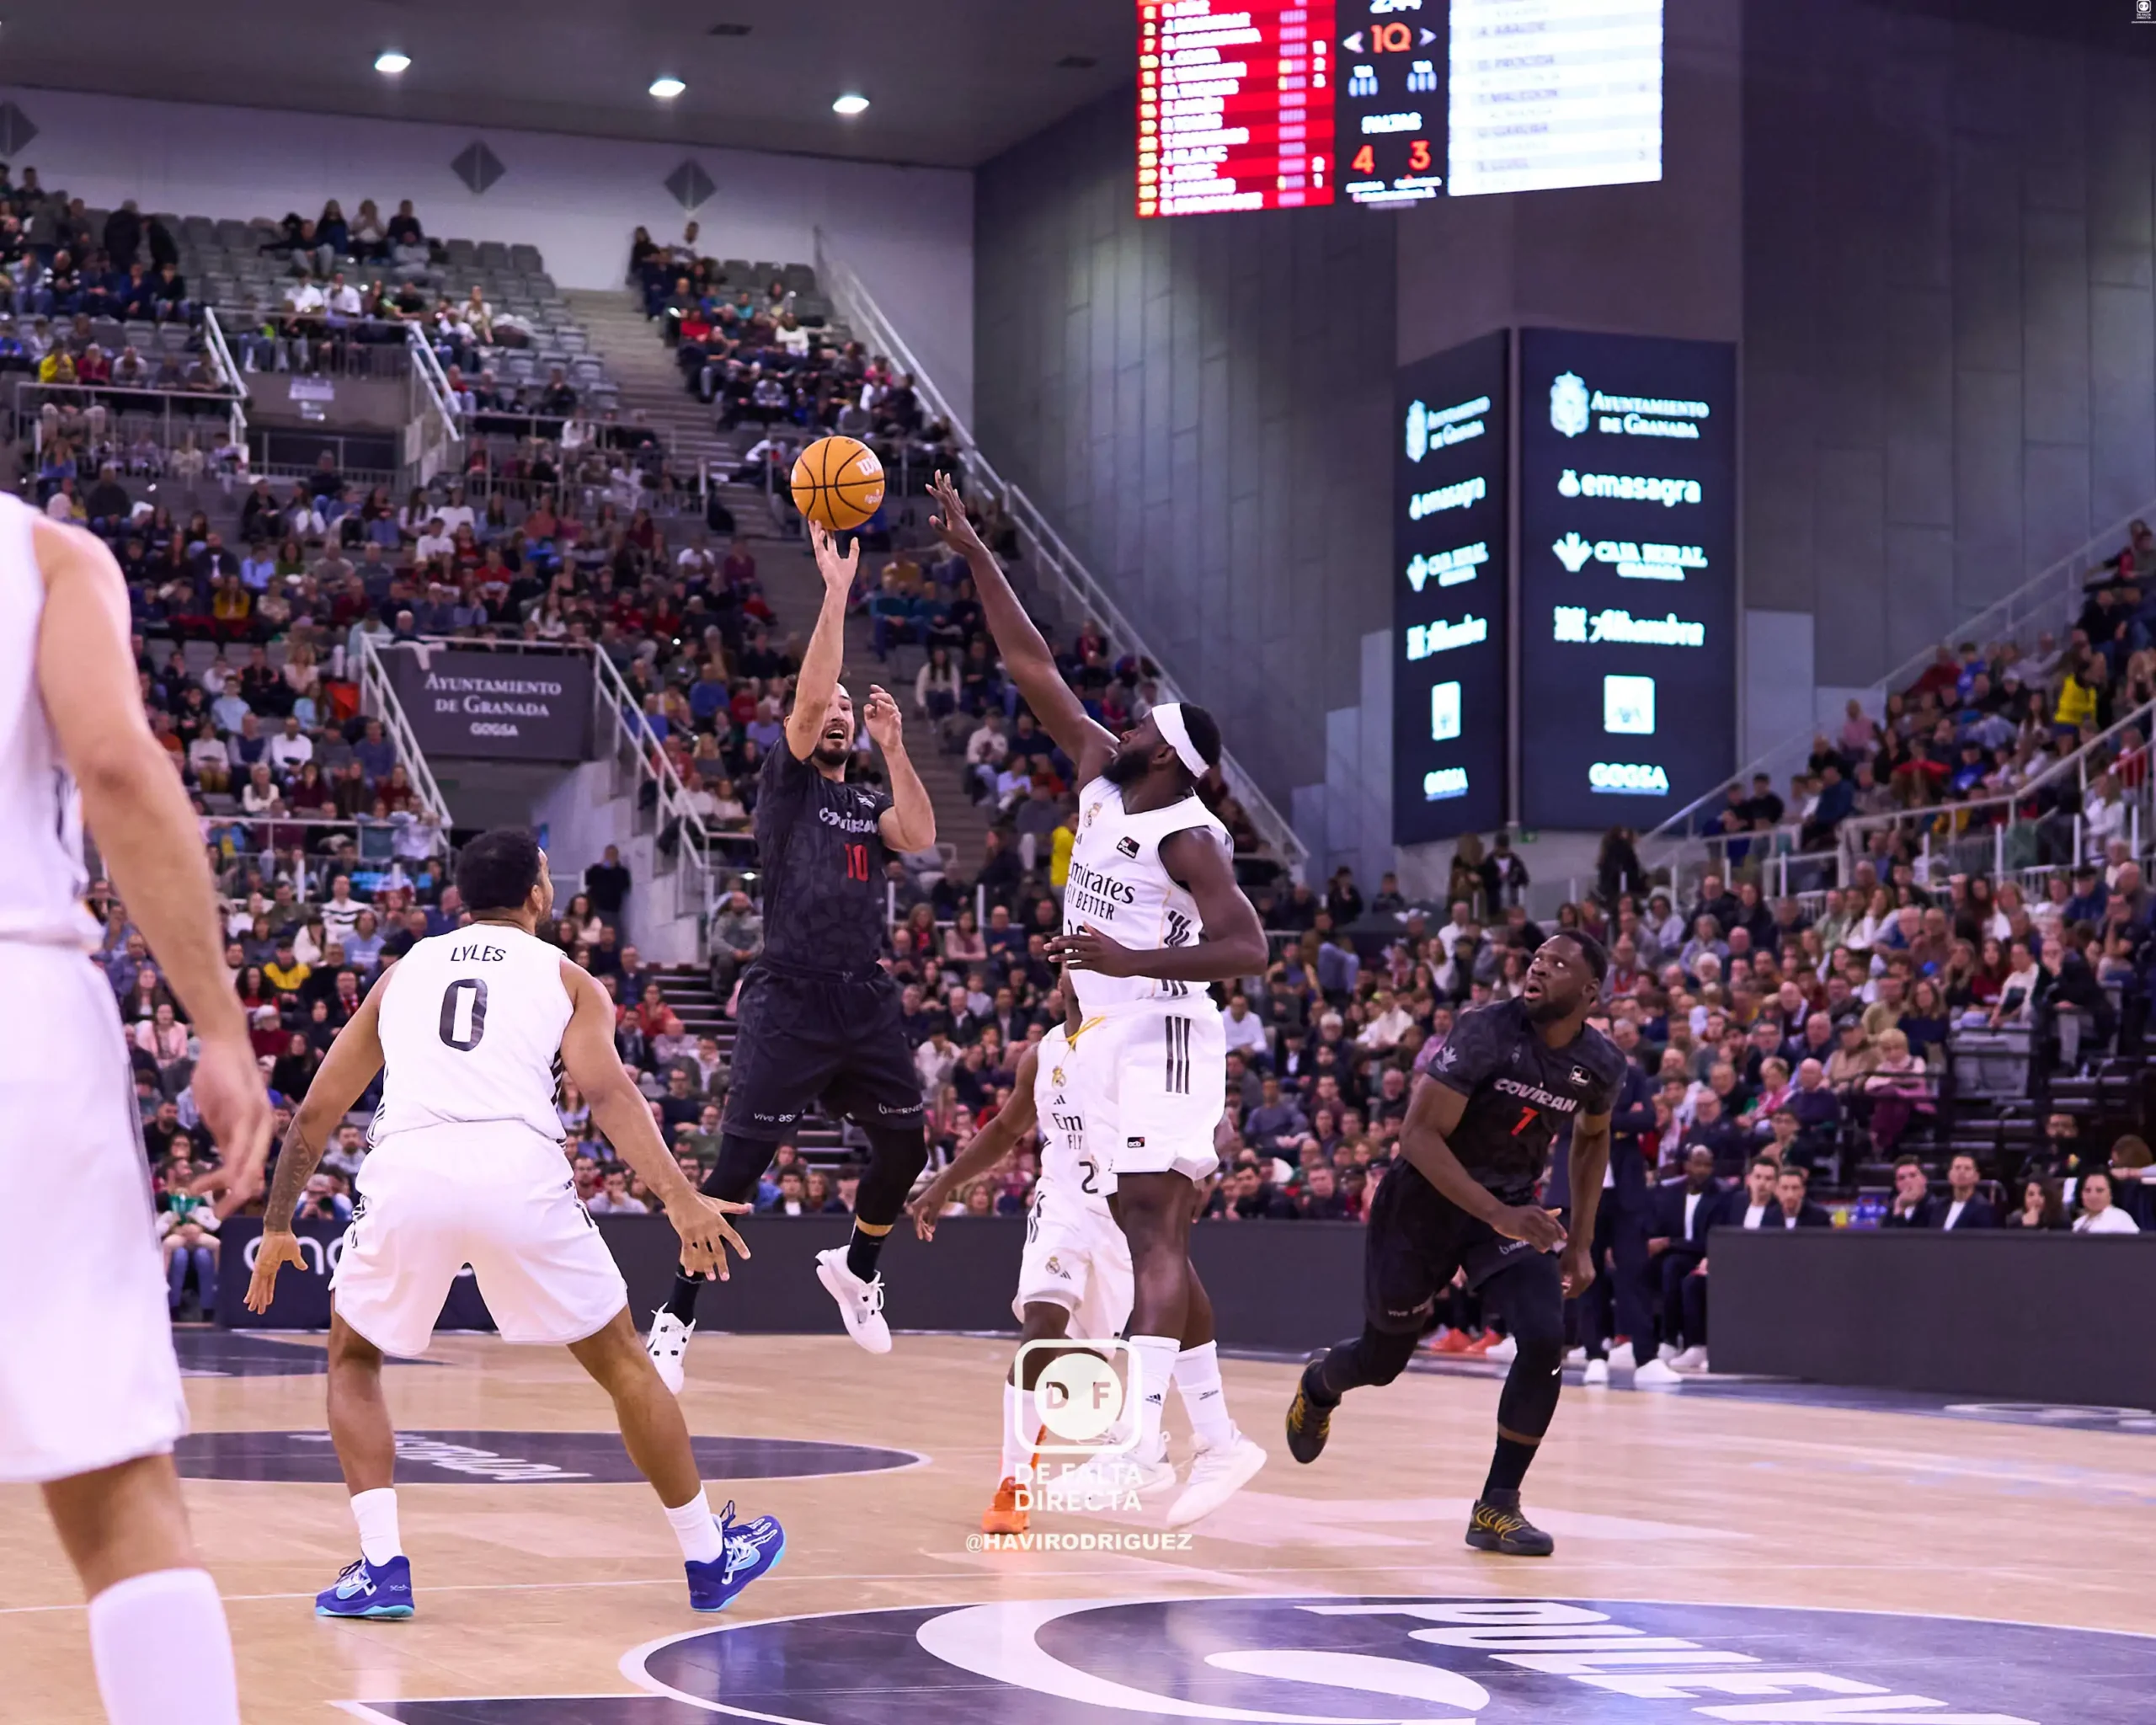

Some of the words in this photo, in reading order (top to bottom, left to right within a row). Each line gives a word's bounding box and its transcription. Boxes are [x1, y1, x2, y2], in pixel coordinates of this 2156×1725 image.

[1371, 22, 1412, 54] 1Q
[1351, 144, 1375, 175] 4
[1408, 139, 1432, 171] 3
[1591, 390, 1710, 419] AYUNTAMIENTO
[1623, 413, 1700, 439] GRANADA
[1580, 473, 1701, 508] emasagra
[424, 672, 562, 696] AYUNTAMIENTO
[435, 697, 460, 713] DE
[463, 694, 550, 718] GRANADA
[844, 843, 868, 883] 10
[1068, 861, 1136, 905] mirates
[1075, 890, 1115, 921] BETTER
[450, 943, 507, 962] LYLES
[439, 978, 488, 1052] 0
[1511, 1106, 1539, 1135] 7
[1067, 1134, 1083, 1151] FLY
